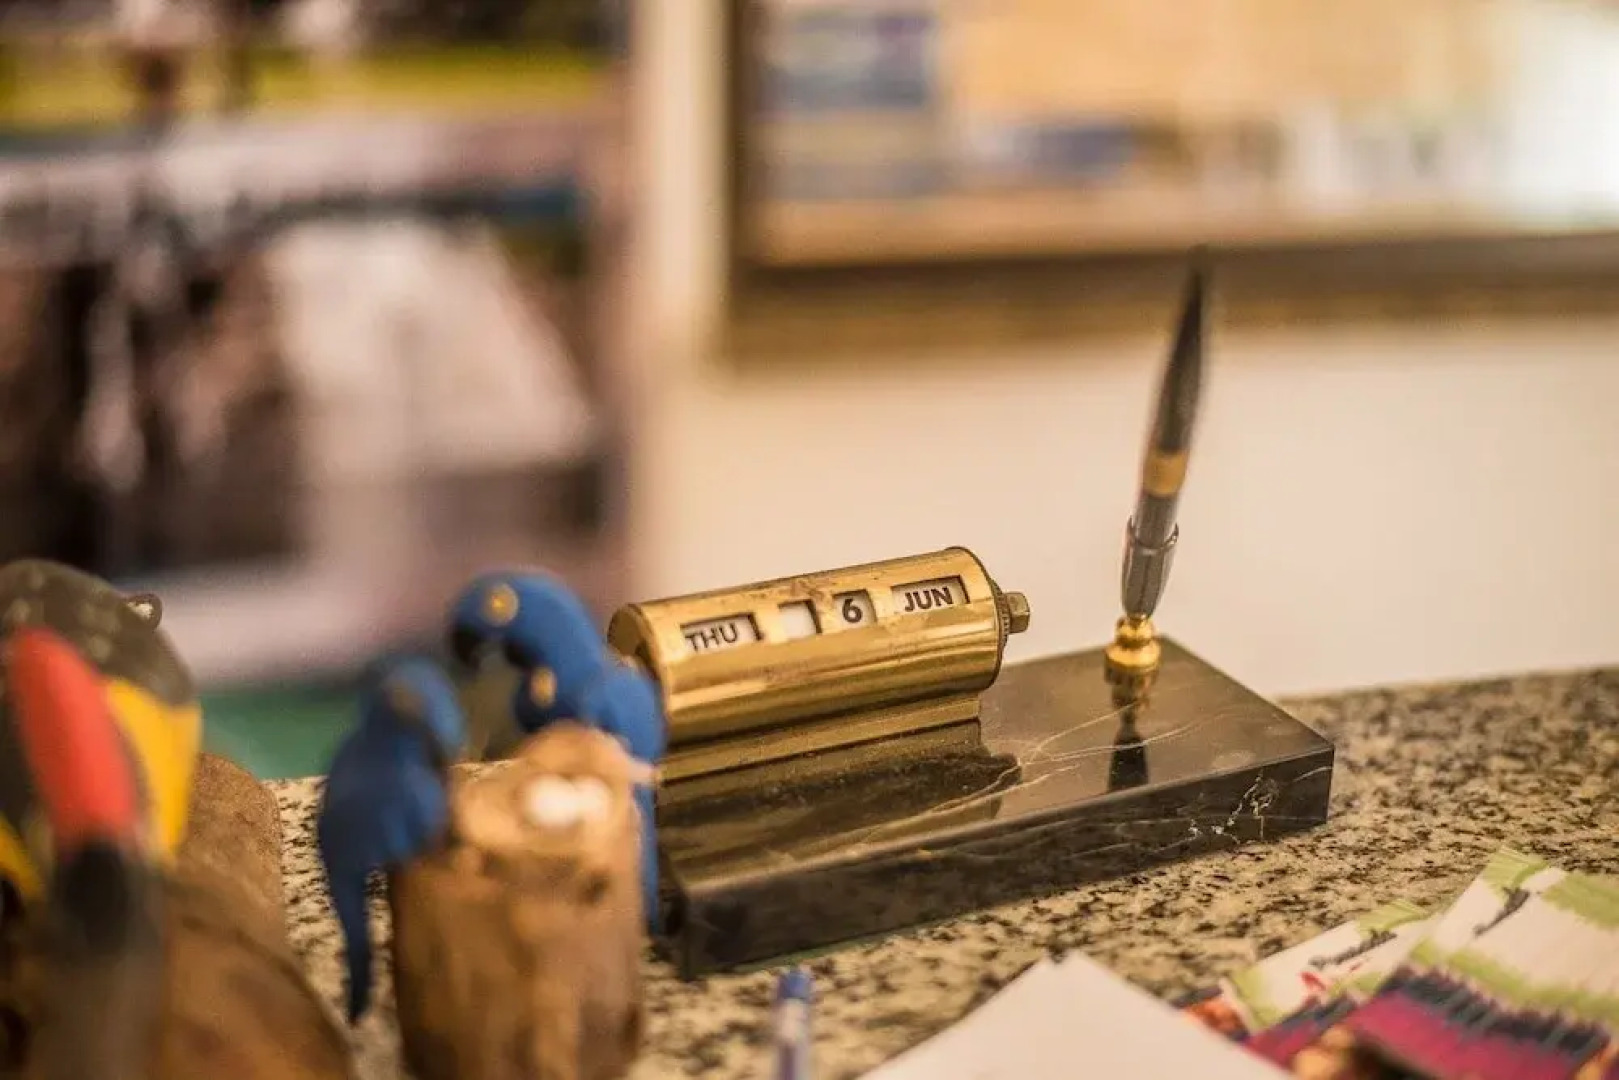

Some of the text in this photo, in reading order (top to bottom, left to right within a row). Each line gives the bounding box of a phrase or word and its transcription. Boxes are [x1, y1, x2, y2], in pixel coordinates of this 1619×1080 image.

[685, 586, 954, 651] THU 6 JUN
